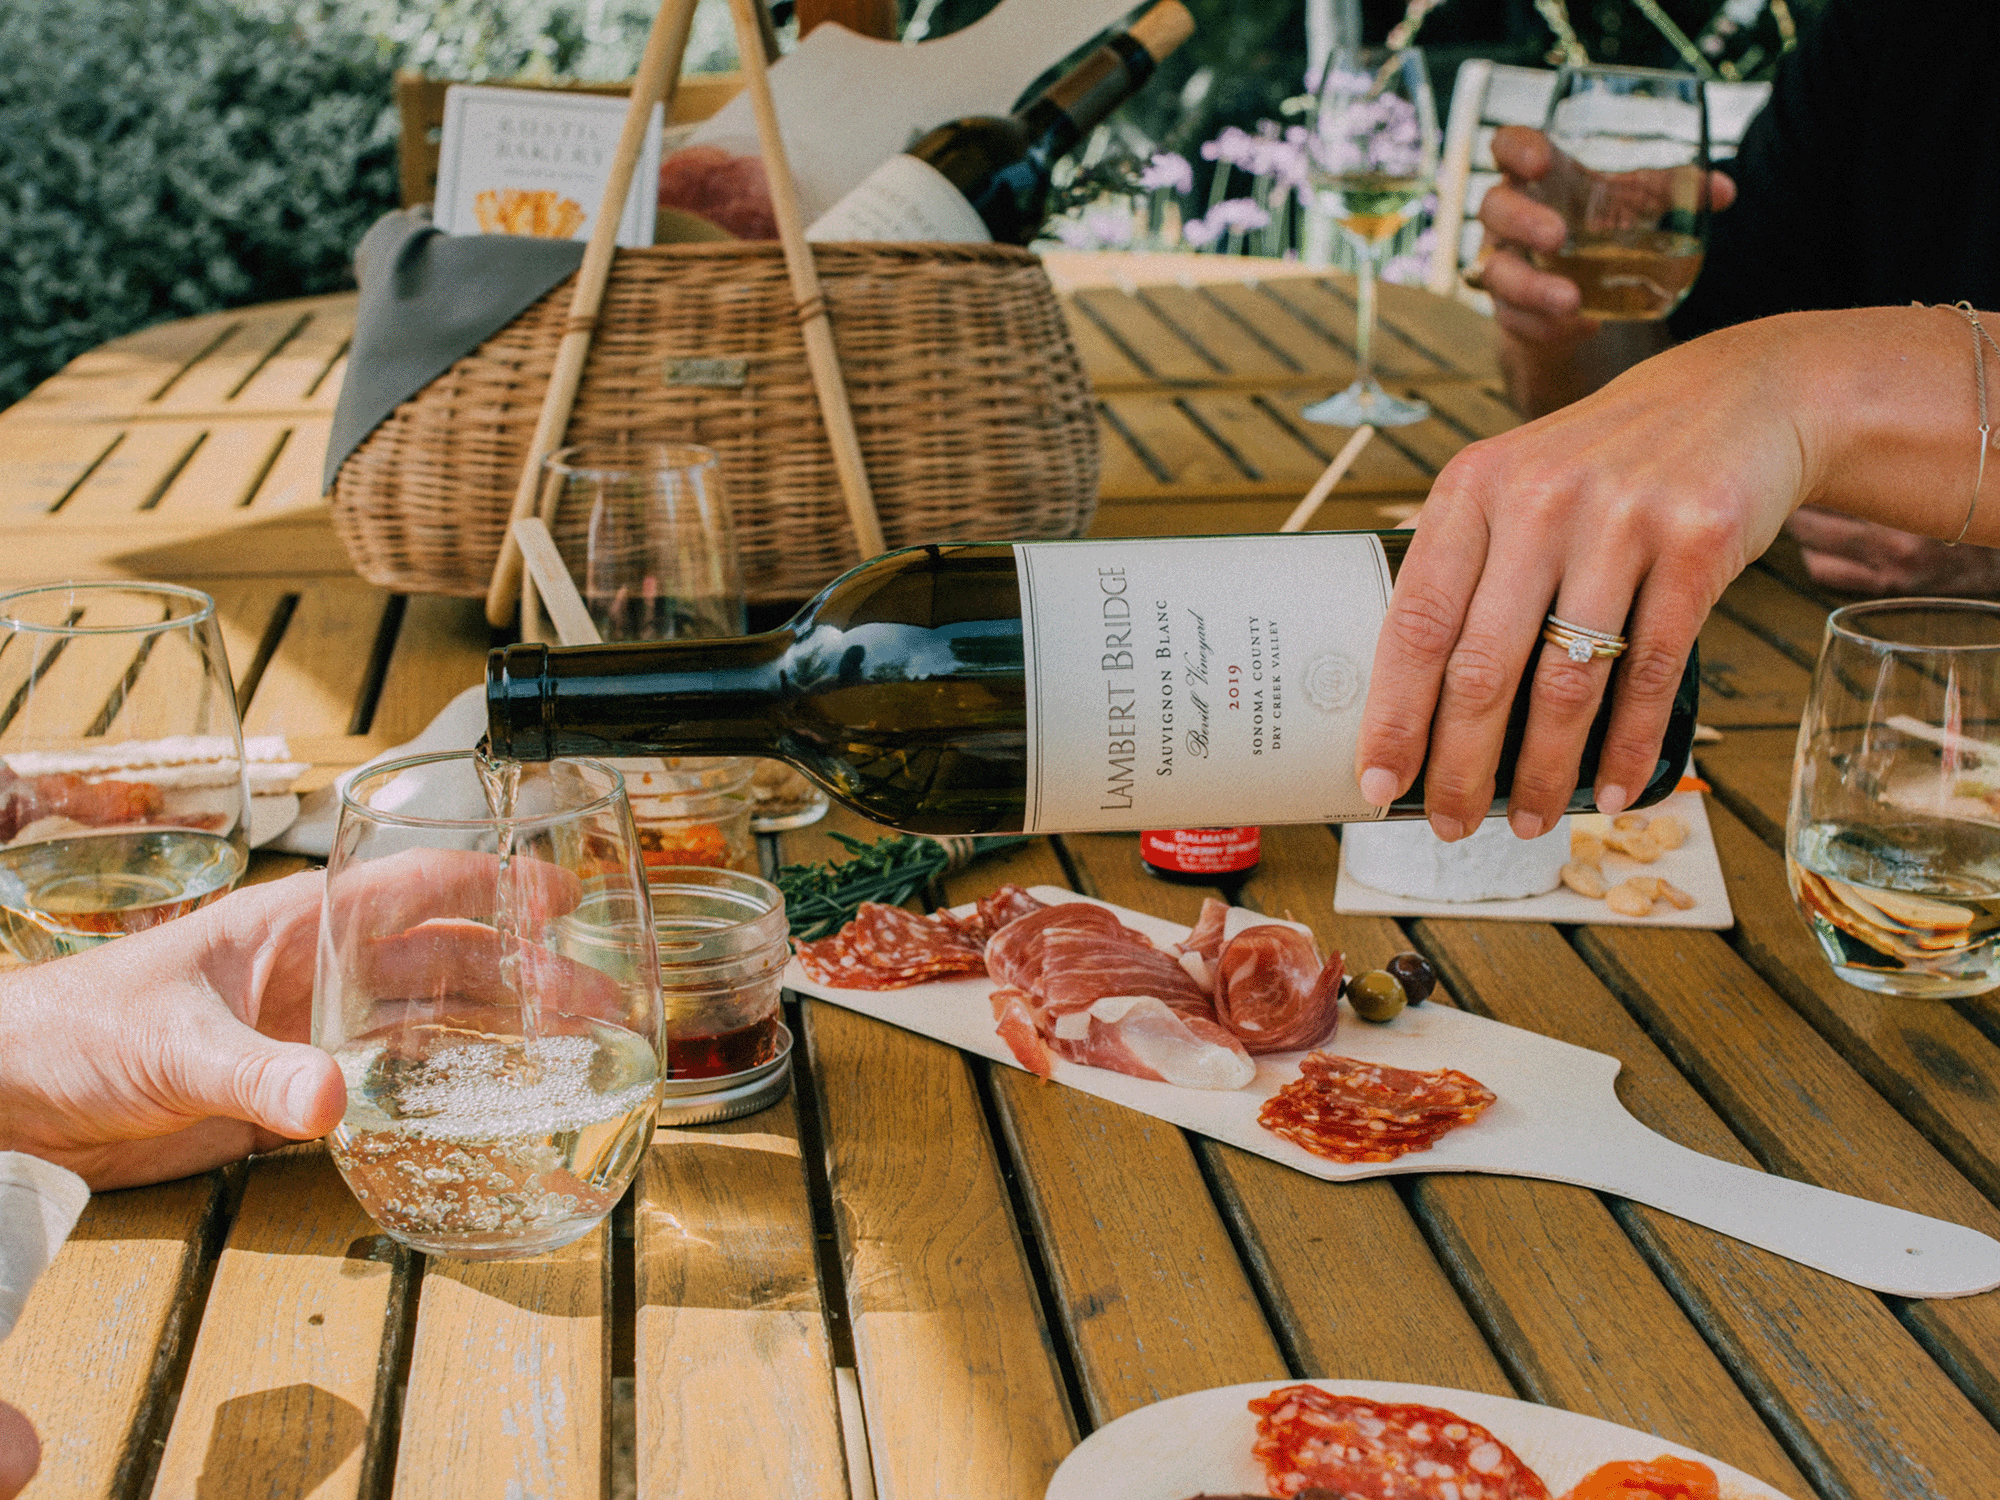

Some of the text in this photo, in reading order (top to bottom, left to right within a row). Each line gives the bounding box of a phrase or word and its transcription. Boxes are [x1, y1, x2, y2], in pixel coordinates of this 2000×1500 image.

[1098, 566, 1135, 811] LAMBERT BRIDGE
[1155, 599, 1173, 776] SAUVIGNON BLANC
[1184, 608, 1214, 759] Bevill Vineyard
[1227, 664, 1243, 711] 2019
[1249, 615, 1263, 756] SONOMA COUNTY
[1268, 619, 1281, 750] DRY CREEK VALLEY
